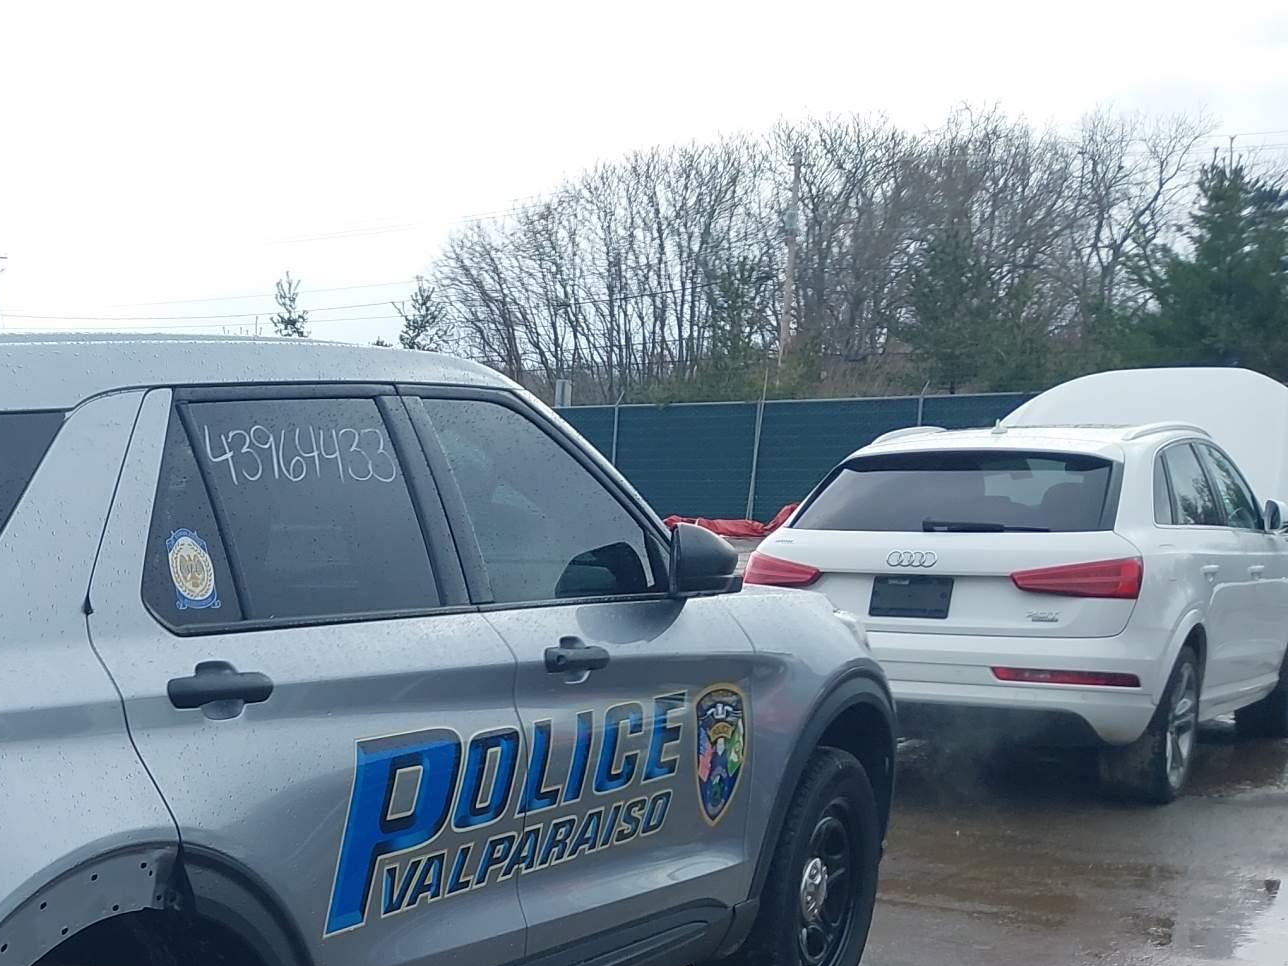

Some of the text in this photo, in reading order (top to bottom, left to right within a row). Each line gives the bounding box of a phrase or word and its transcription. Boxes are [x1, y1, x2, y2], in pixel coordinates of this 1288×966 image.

[204, 424, 397, 485] 43964433
[322, 689, 688, 938] POLICE
[380, 789, 673, 918] VALPARAISO
